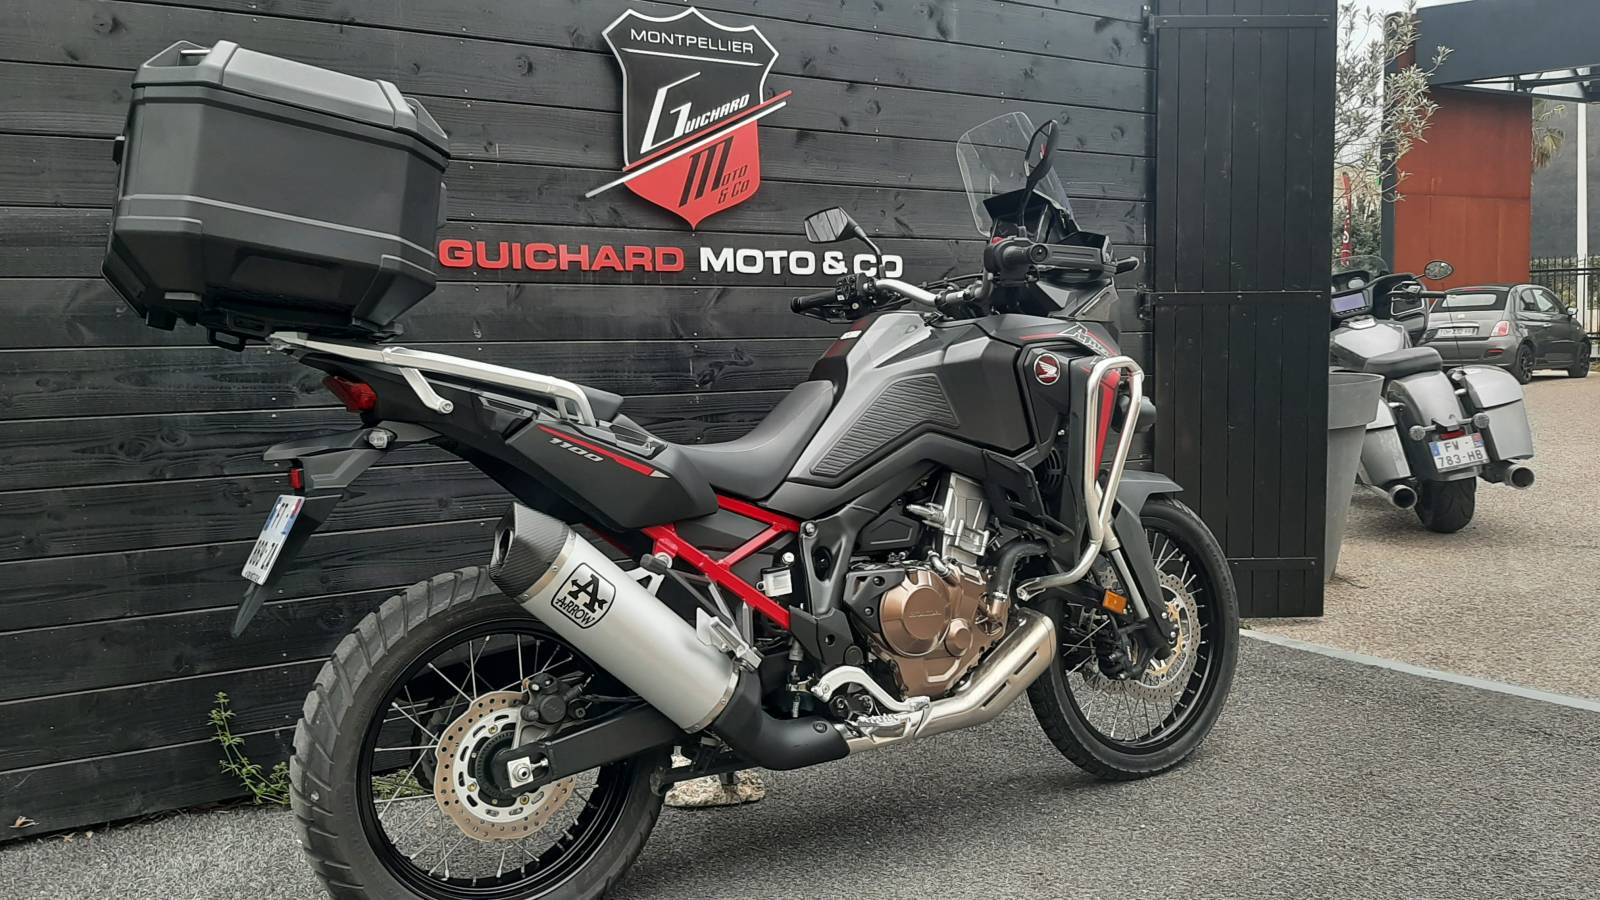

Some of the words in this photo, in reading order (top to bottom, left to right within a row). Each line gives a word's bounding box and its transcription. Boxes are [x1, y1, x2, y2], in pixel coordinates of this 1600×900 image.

[630, 28, 754, 54] MONTPELLIER
[639, 71, 750, 154] GUICHARD
[438, 239, 685, 273] GUICHARD
[548, 437, 604, 462] 1100
[1436, 449, 1484, 467] 783-HB
[555, 596, 596, 625] ARROW
